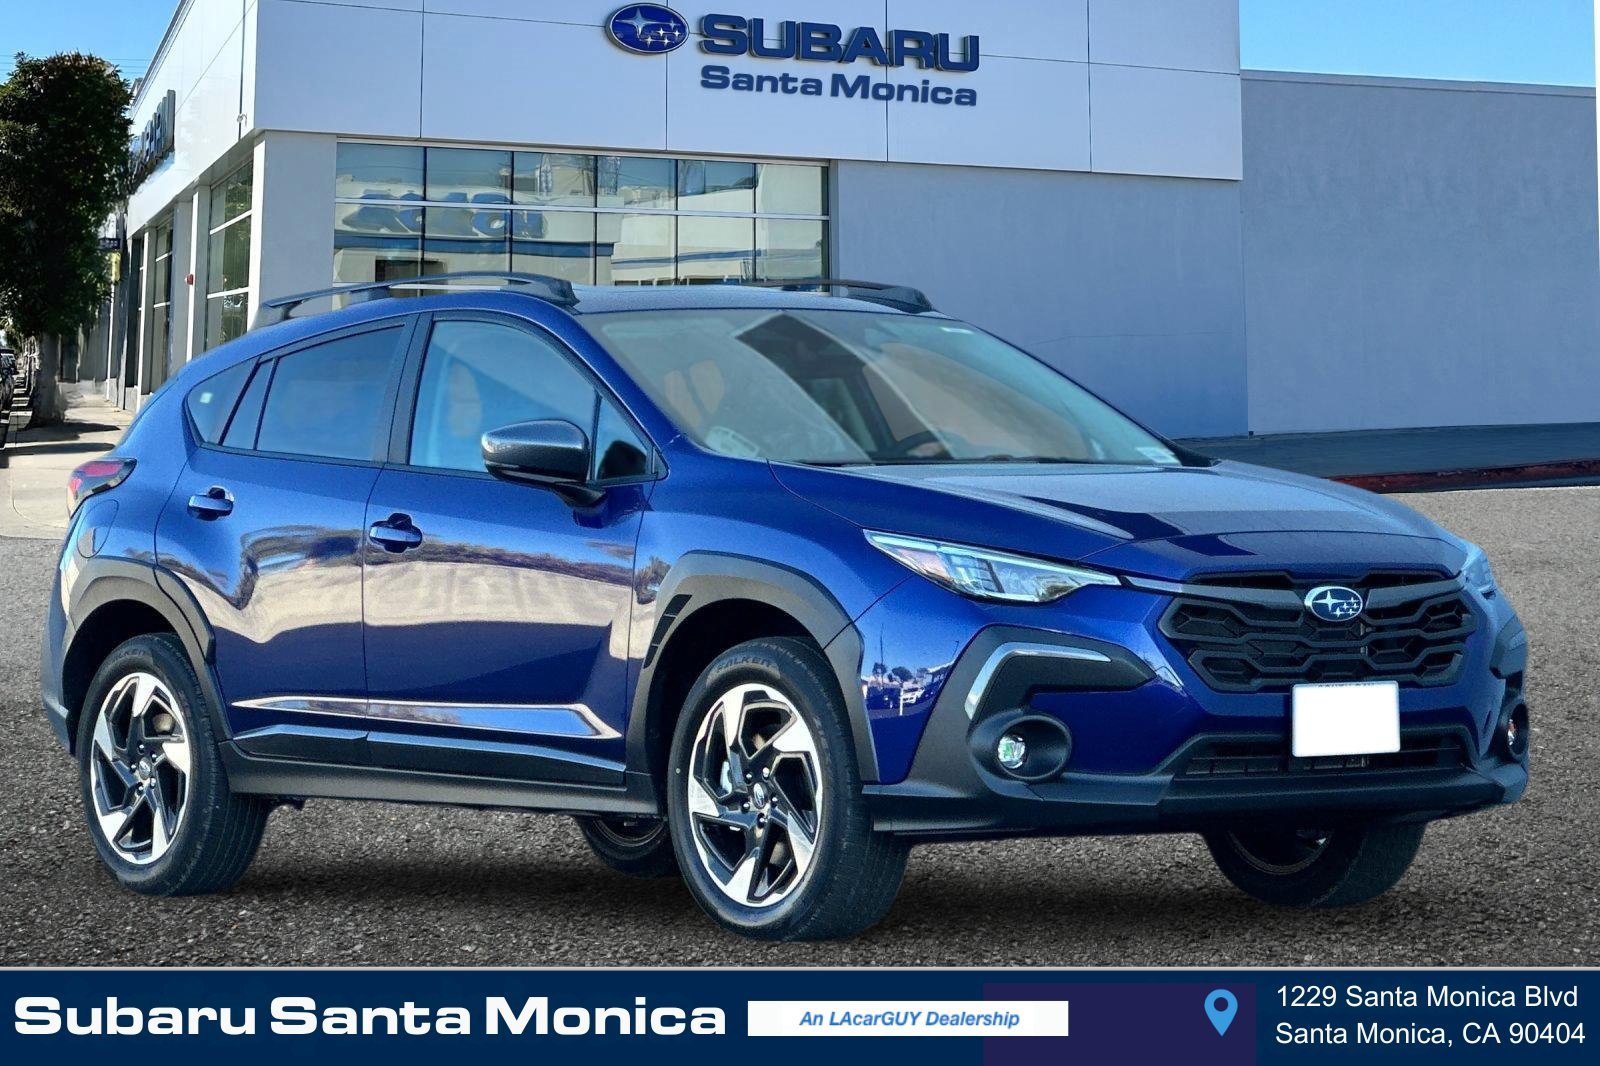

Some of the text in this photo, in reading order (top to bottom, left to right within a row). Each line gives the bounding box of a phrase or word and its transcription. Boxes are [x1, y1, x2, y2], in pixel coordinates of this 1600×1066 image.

[700, 13, 980, 72] SUBARU
[700, 64, 978, 107] Santa Monica
